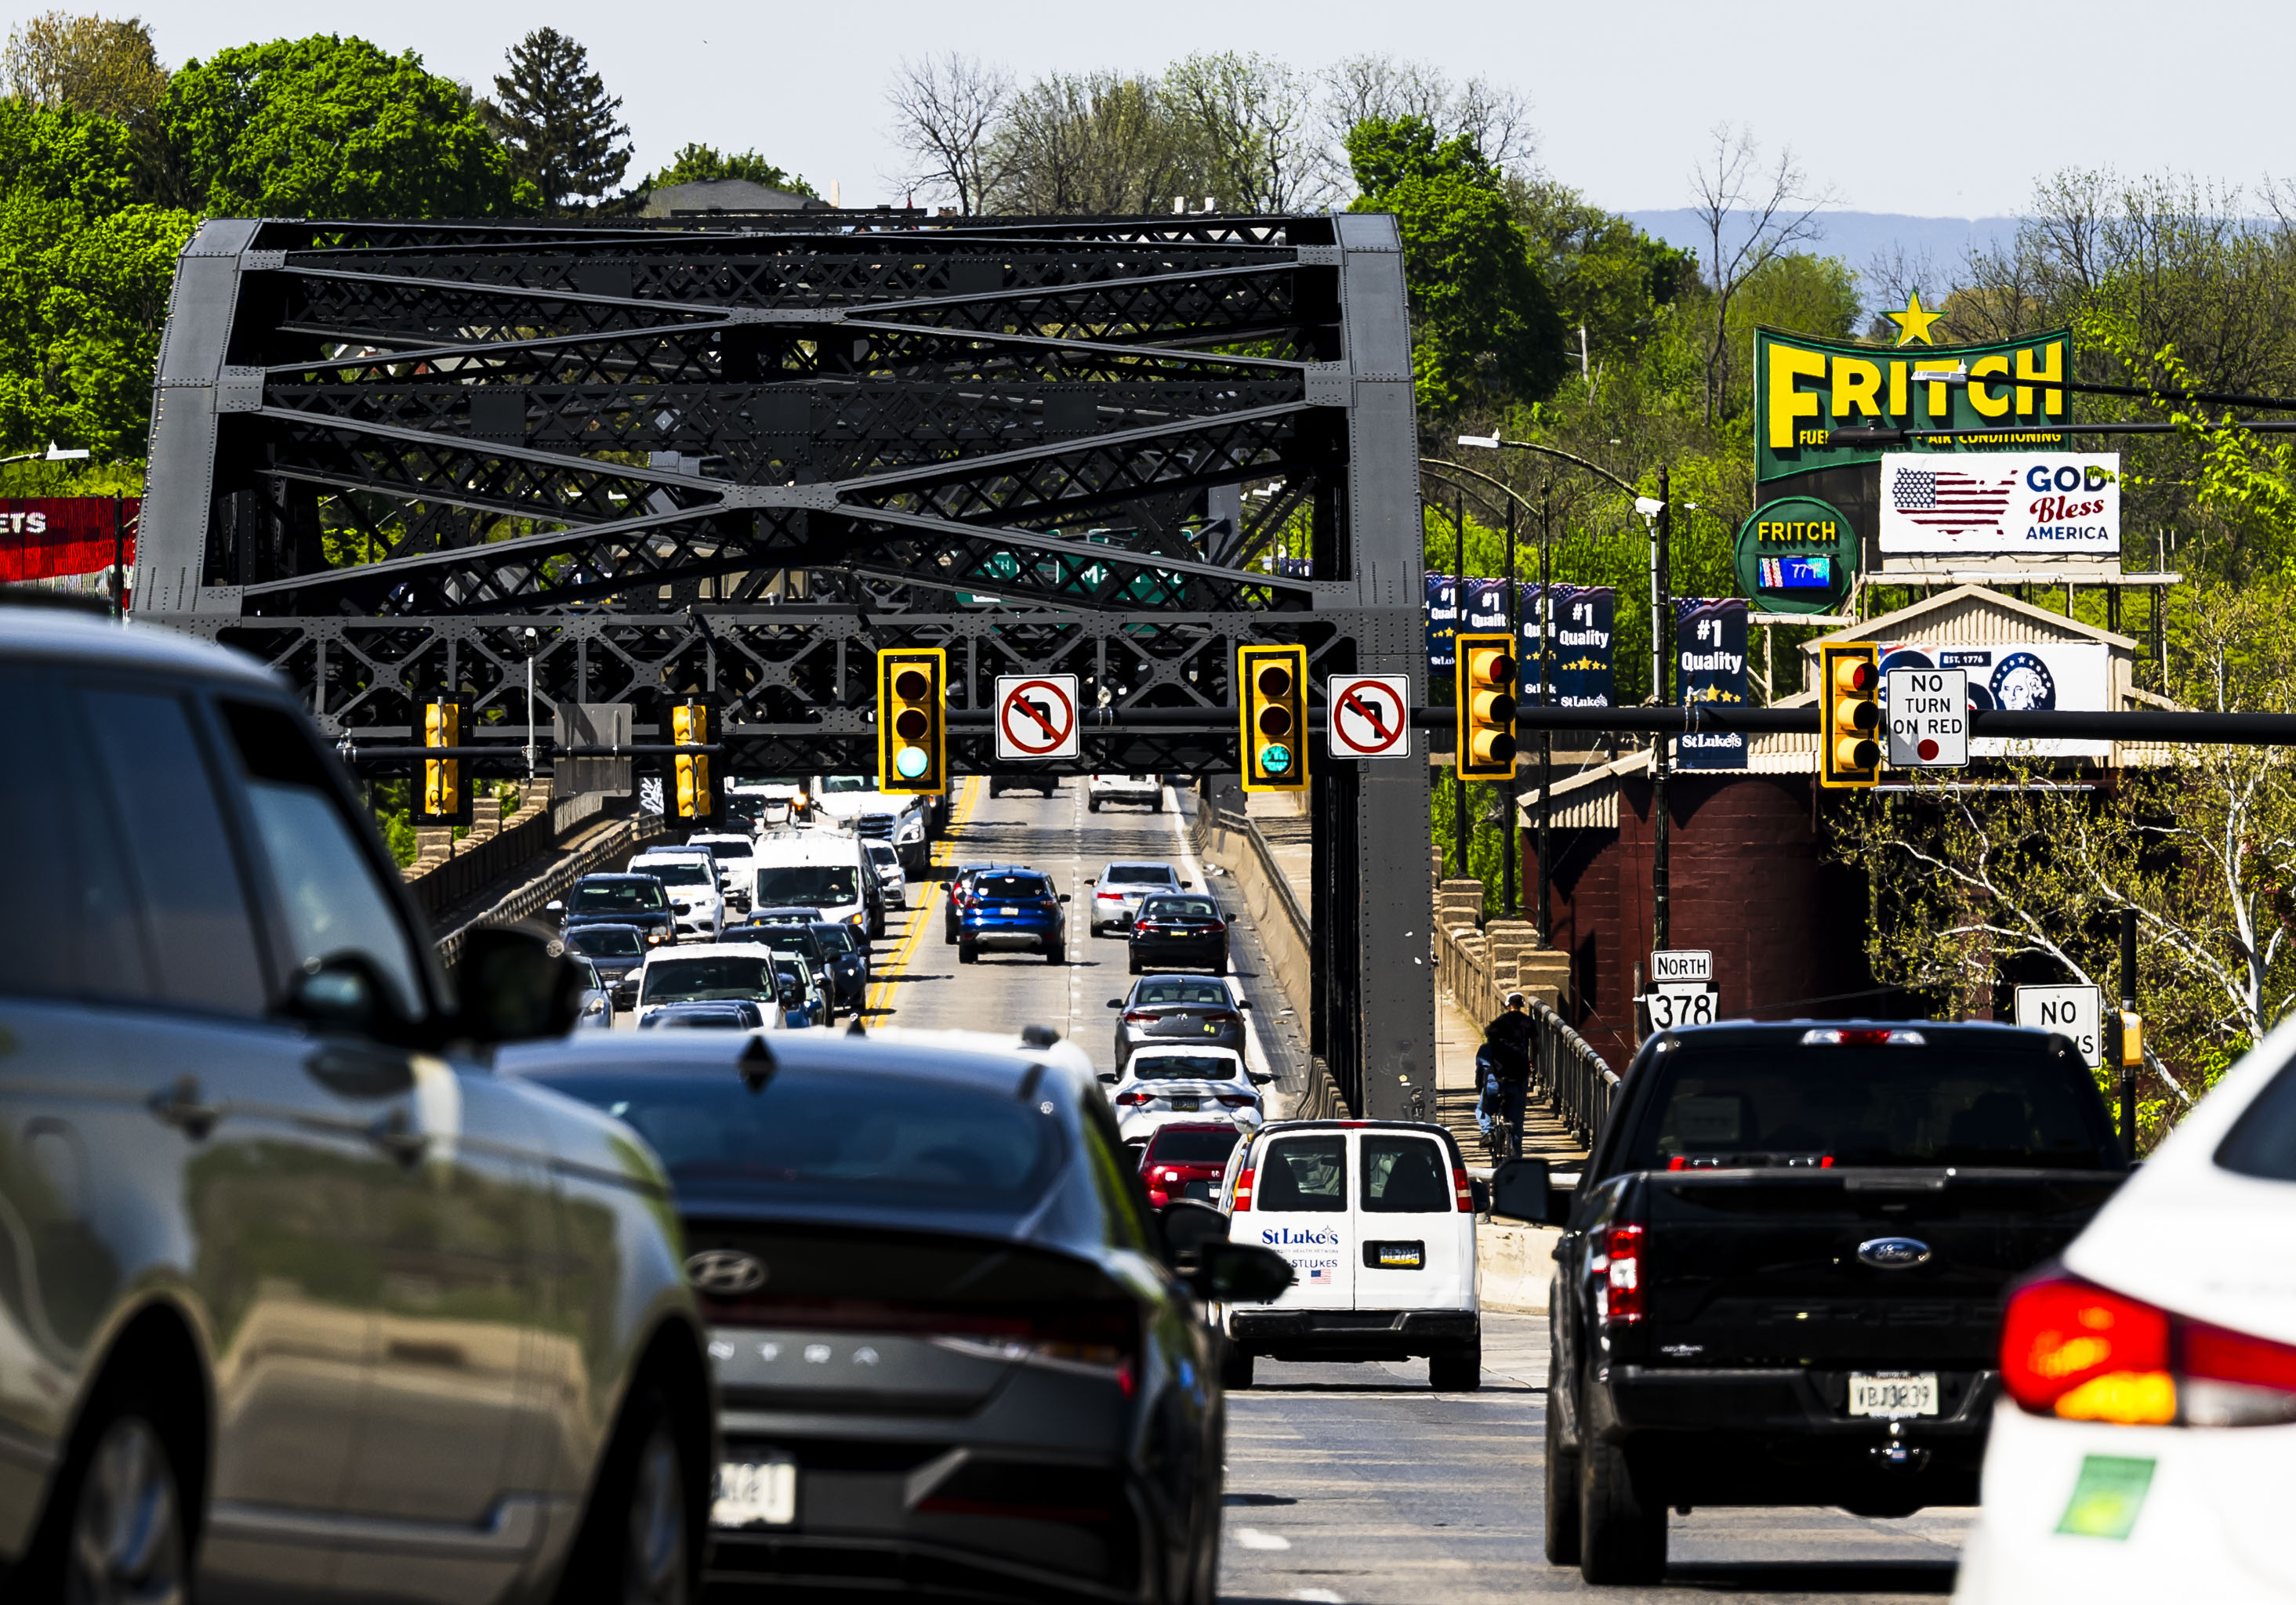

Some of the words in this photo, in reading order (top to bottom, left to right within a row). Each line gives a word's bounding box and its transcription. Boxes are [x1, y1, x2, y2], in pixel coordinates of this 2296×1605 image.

[1768, 340, 2062, 448] FRITCH
[1800, 430, 1830, 444] FUE
[2026, 466, 2108, 492] GOD
[2029, 495, 2105, 524] Bless
[1758, 521, 1835, 541] FRITCH
[2026, 526, 2109, 540] AMERICA
[1441, 588, 1456, 606] #1
[1482, 592, 1500, 611] #1
[1471, 613, 1507, 628] Qualit
[1572, 603, 1593, 627] #1
[1559, 629, 1609, 649] Quality
[1697, 619, 1721, 647] #1
[1681, 651, 1742, 675] Quality
[1943, 655, 1960, 664] EST.
[1963, 655, 1984, 664] 1776
[1911, 675, 1943, 692] NO
[1905, 697, 1951, 713] TURN
[1893, 718, 1918, 734] ON
[1928, 719, 1963, 734] RED
[1658, 957, 1706, 975] NORTH
[1655, 995, 1712, 1029] 378
[2041, 1001, 2076, 1025] NO
